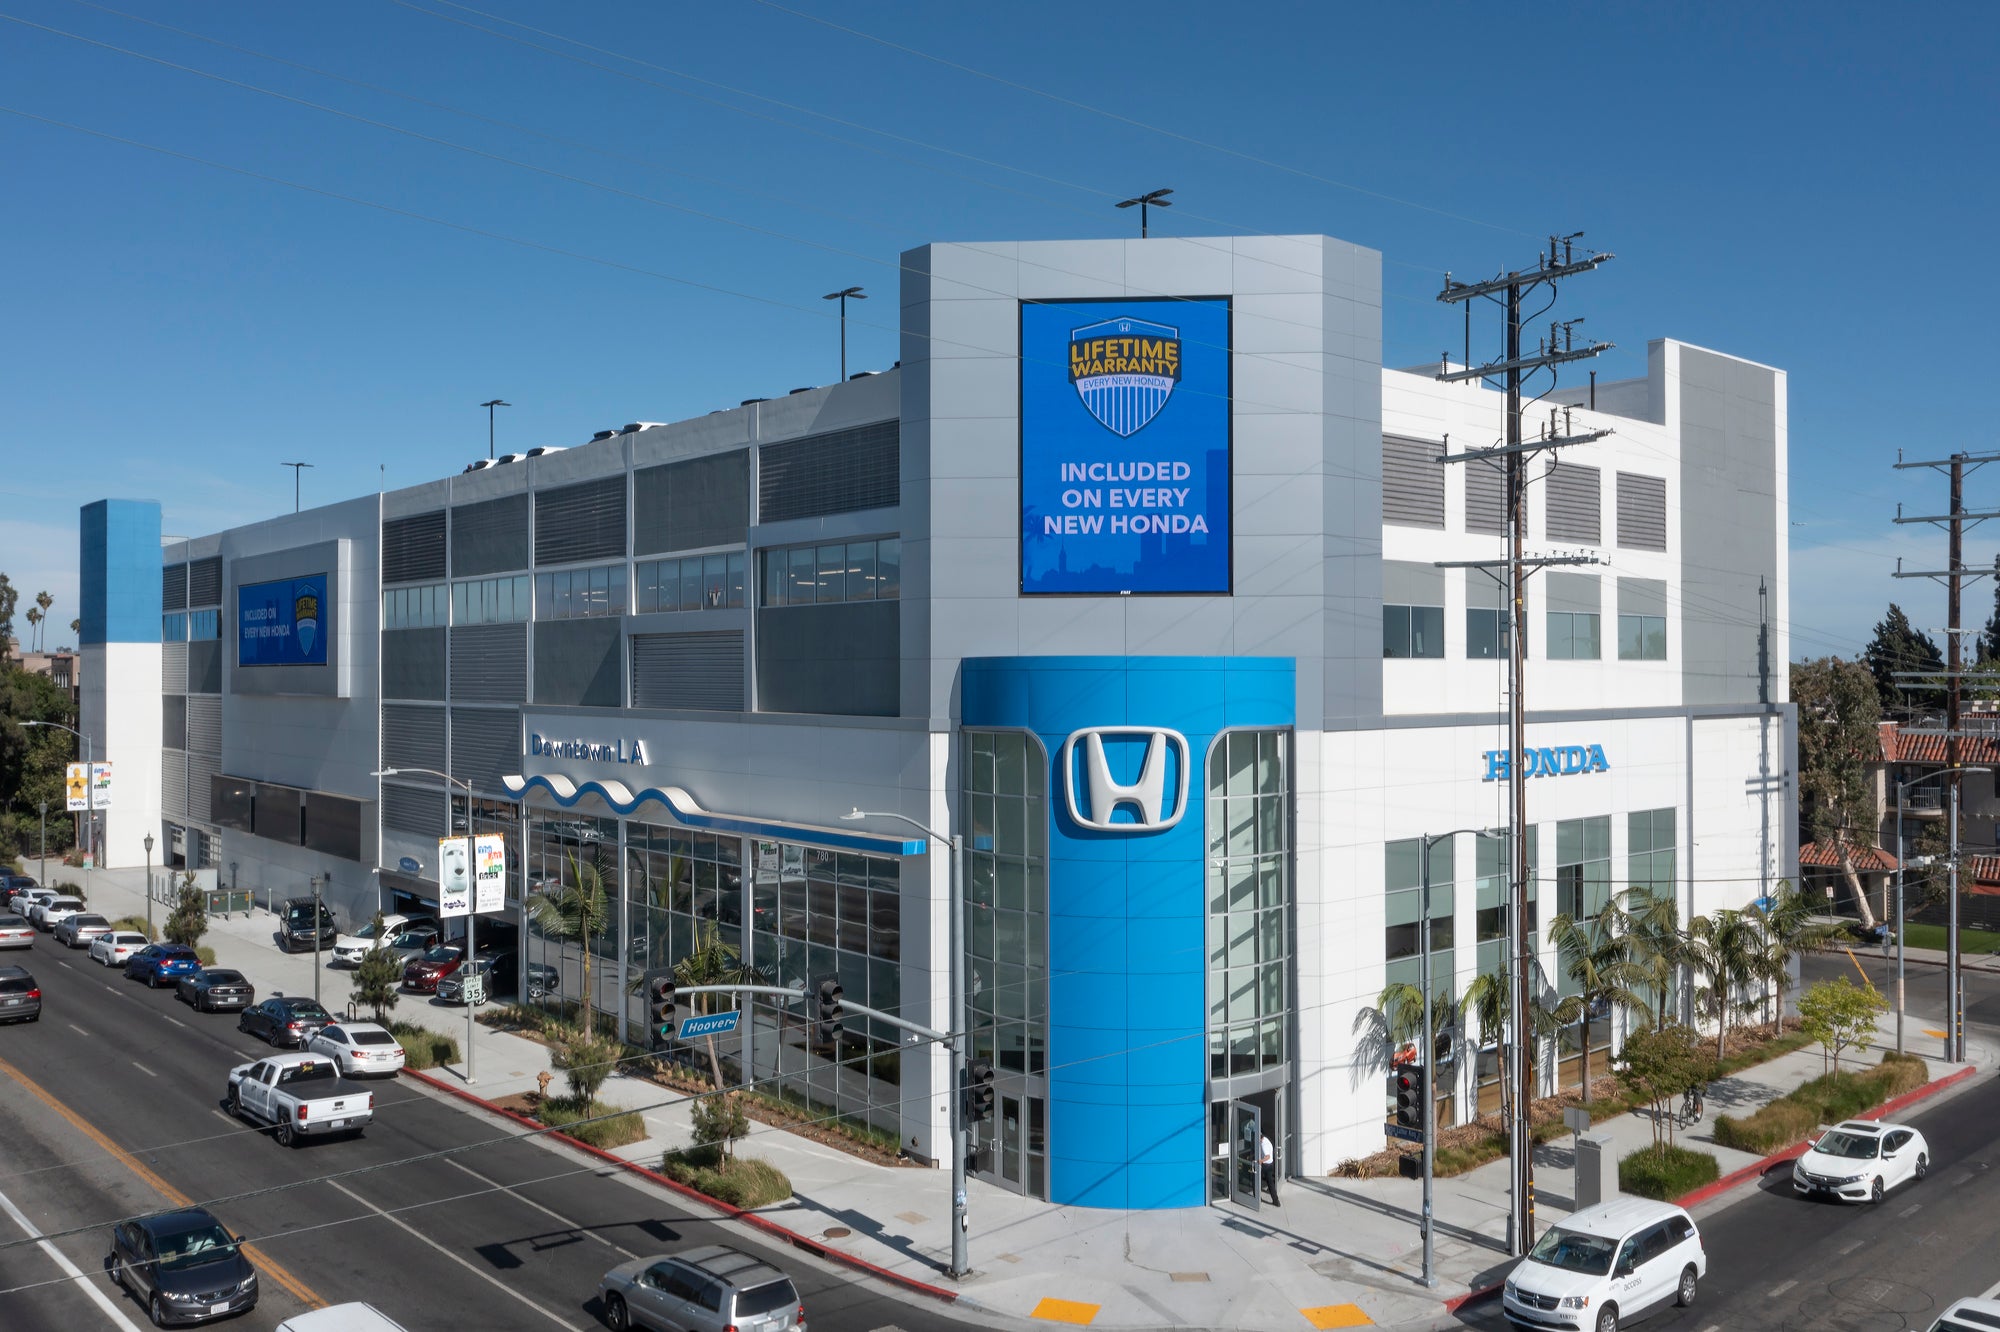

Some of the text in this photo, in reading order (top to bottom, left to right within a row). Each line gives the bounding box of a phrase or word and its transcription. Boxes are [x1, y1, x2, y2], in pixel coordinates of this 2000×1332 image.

[1071, 338, 1178, 363] LIFETIME
[1071, 357, 1178, 377] WARRANTY
[1083, 376, 1167, 389] EVERY NEW HONDA
[1061, 461, 1191, 482] INCLUDED
[1061, 488, 1190, 508] ON EVERY
[1044, 514, 1209, 535] NEW HONDA
[244, 607, 277, 621] INCLUDED ON
[244, 624, 290, 639] EVERY NEW HONDA
[532, 733, 647, 765] Downtown LA
[1482, 744, 1610, 782] HONDA
[816, 850, 829, 862] 780
[467, 989, 480, 999] 35
[687, 1019, 730, 1033] Hoover
[1623, 1277, 1642, 1292] access
